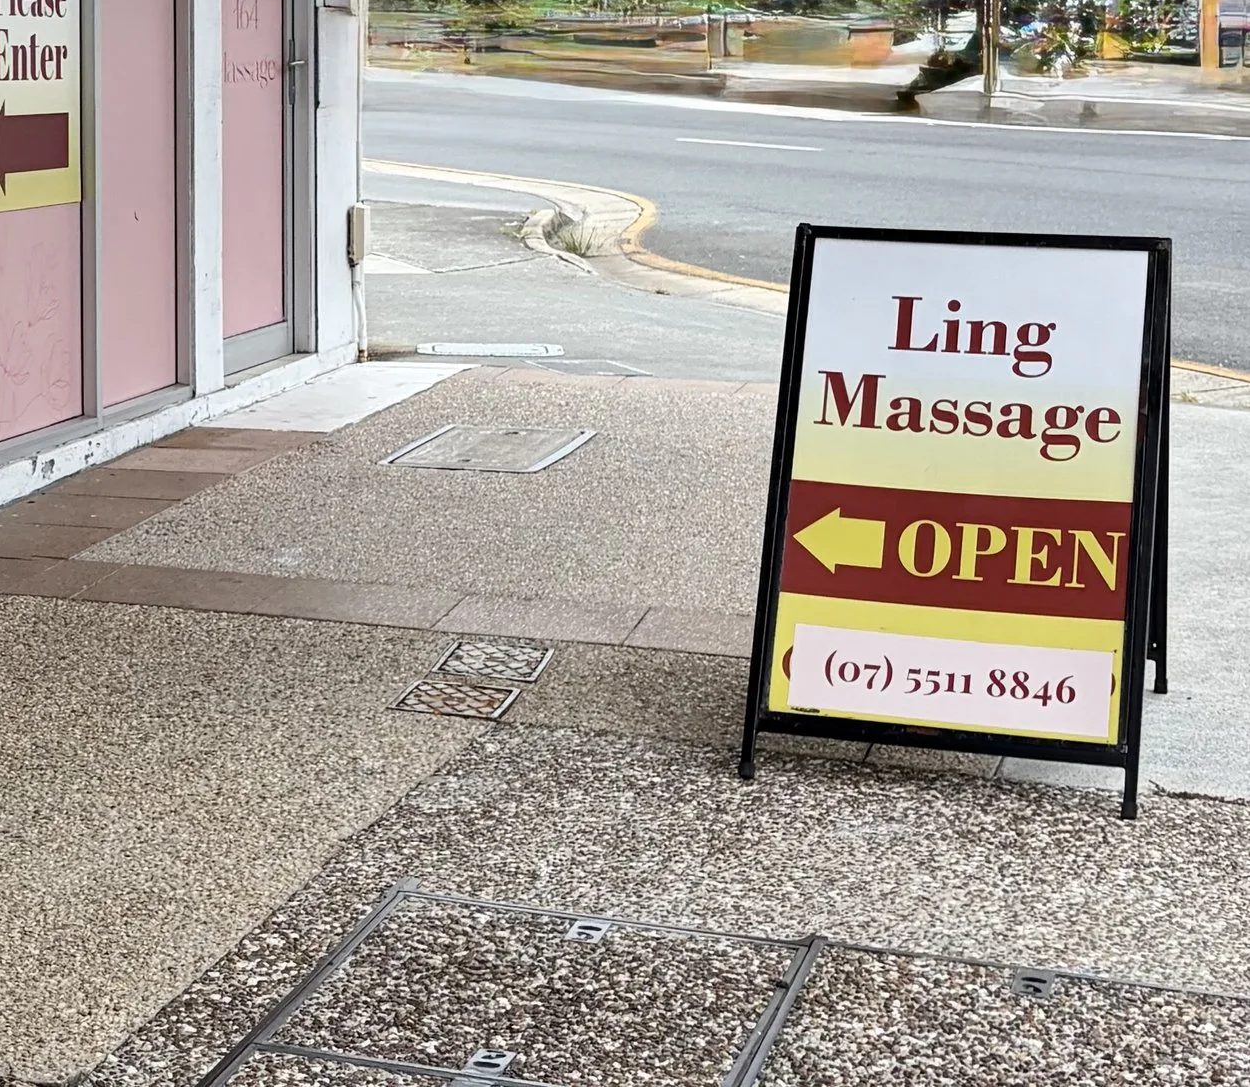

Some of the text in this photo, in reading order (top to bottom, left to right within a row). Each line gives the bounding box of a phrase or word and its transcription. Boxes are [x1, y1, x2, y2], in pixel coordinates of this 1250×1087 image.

[887, 295, 1056, 378] Ling
[812, 370, 1122, 462] Massage
[897, 518, 1126, 592] OPEN
[824, 649, 1076, 707] (07) 5511 8846
